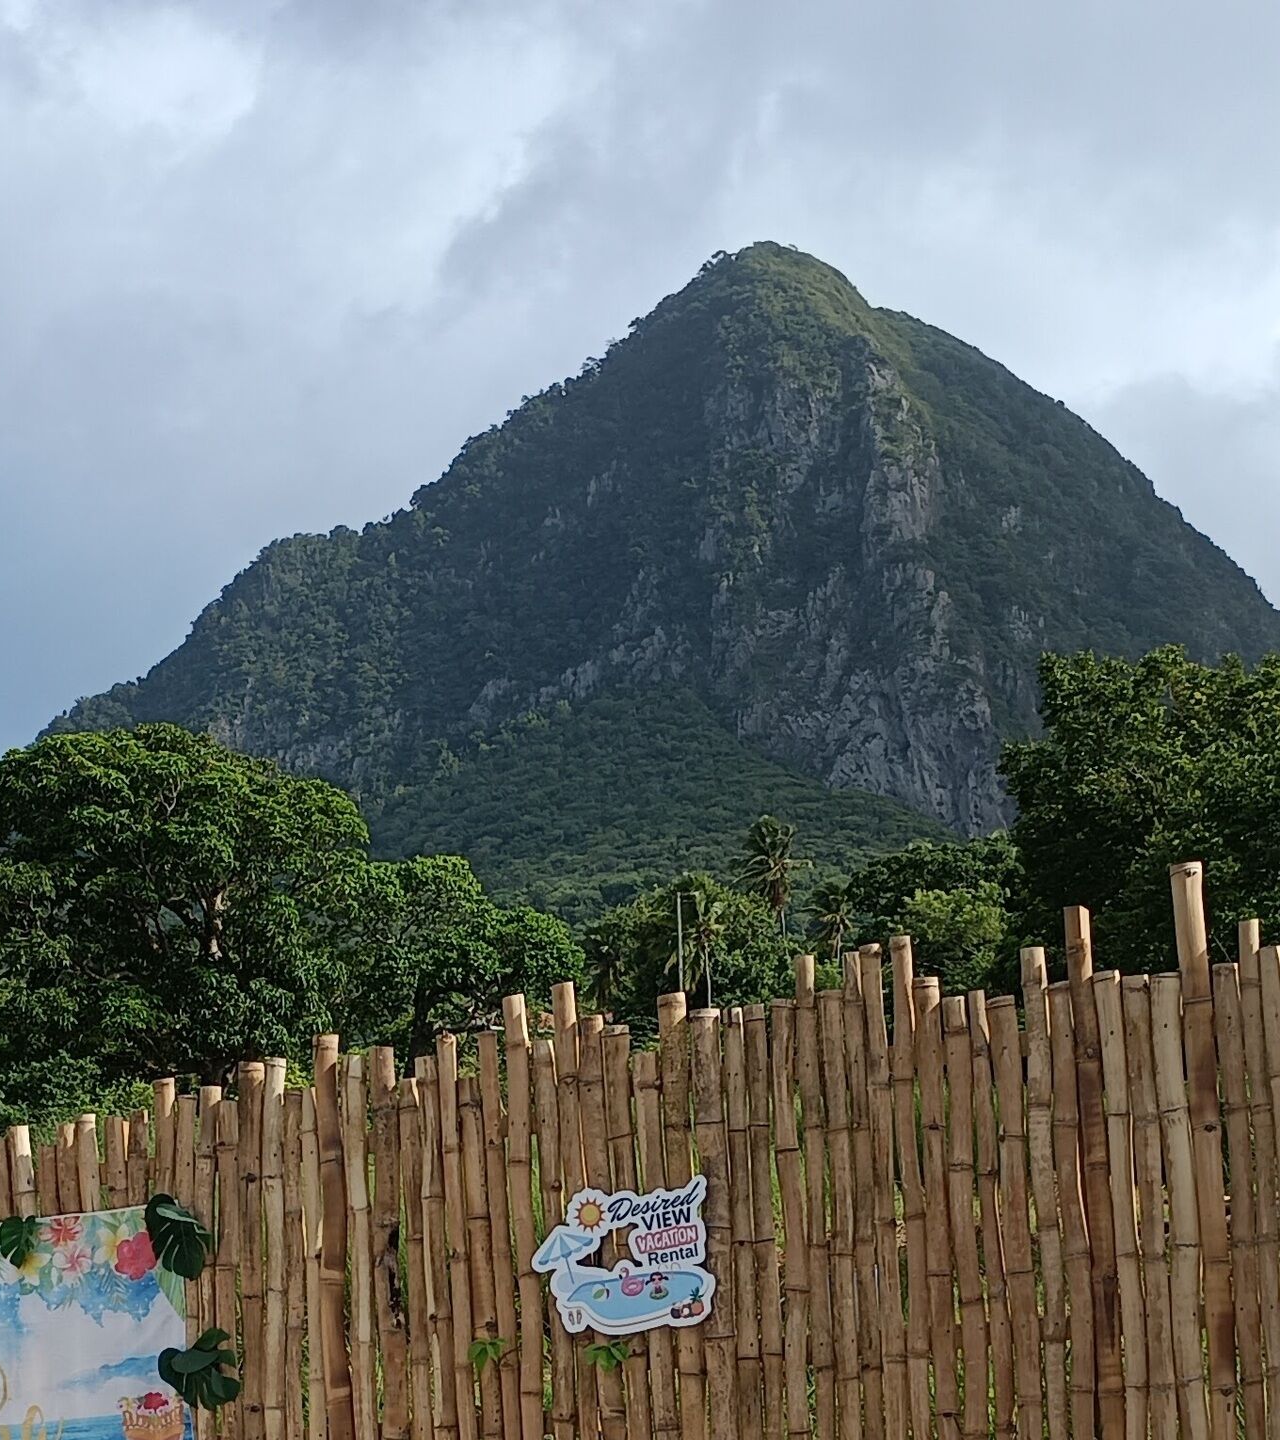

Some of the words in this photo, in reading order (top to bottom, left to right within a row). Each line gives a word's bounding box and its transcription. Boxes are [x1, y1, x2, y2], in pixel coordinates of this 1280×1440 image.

[607, 1180, 701, 1223] Desired
[640, 1206, 691, 1231] VIEW
[635, 1225, 699, 1254] VACATION
[647, 1242, 699, 1267] Rental
